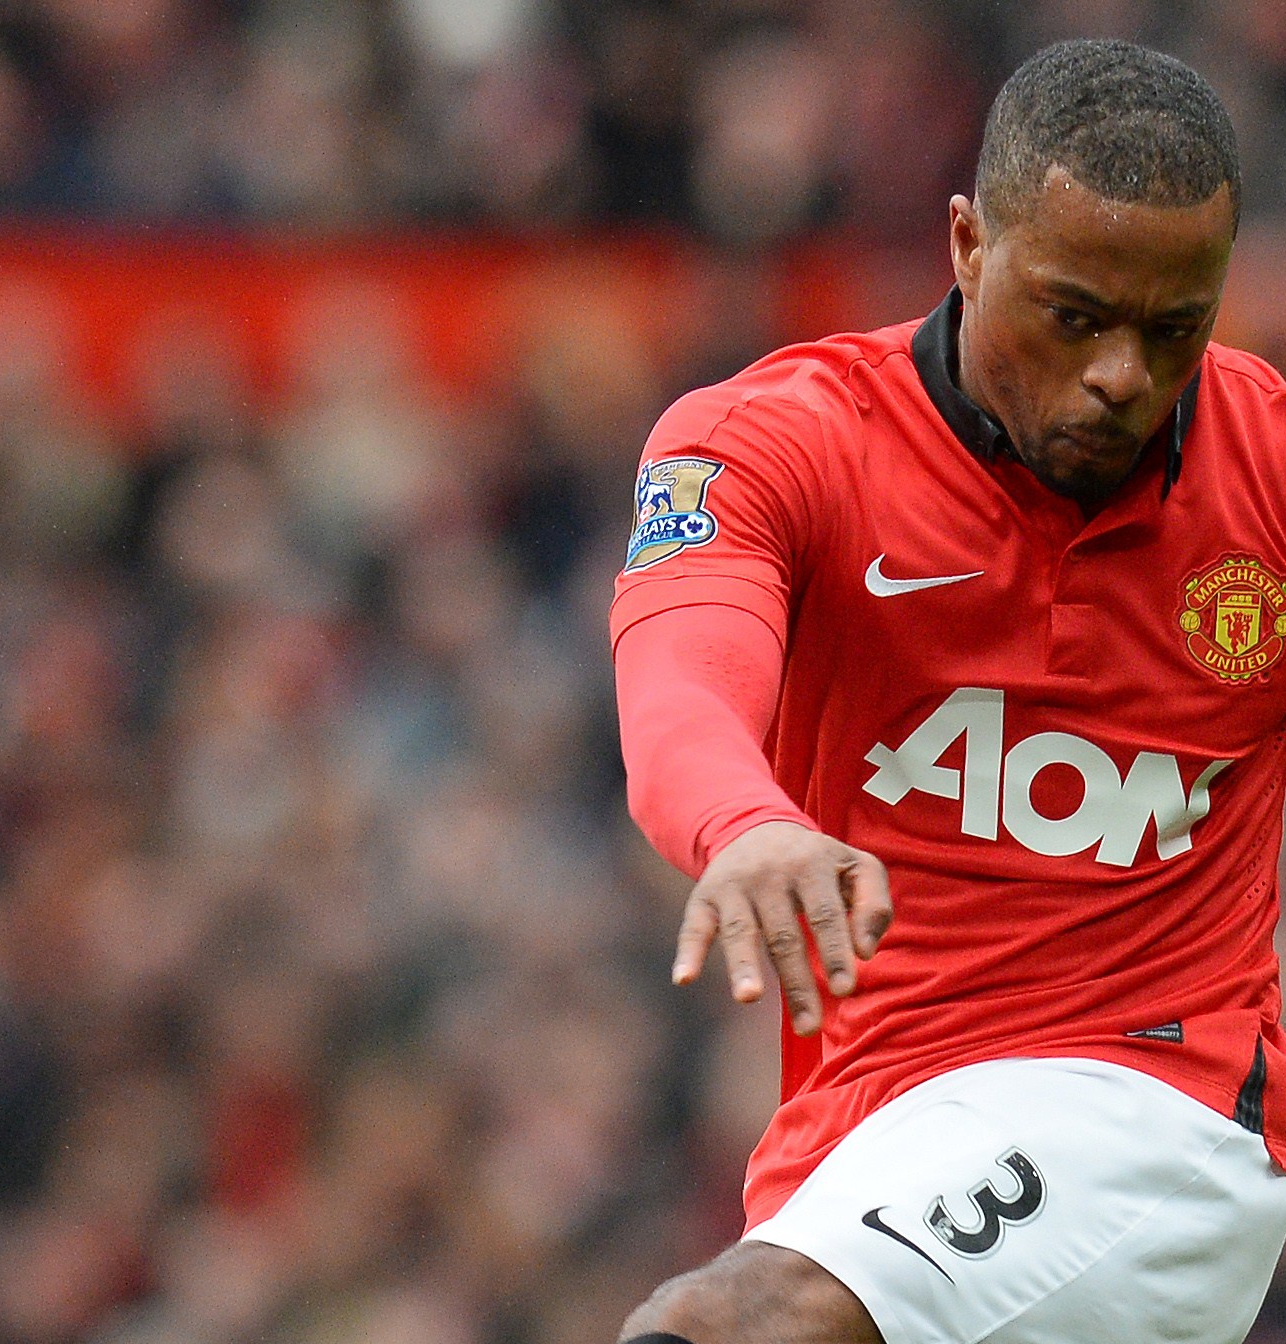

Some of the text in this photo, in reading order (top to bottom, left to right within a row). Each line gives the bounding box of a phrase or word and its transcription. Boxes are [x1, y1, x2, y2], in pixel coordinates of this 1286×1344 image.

[1194, 568, 1284, 607] MANCHESTER
[1204, 649, 1267, 671] UNITED
[862, 687, 1234, 868] AON
[923, 1146, 1048, 1260] 3
